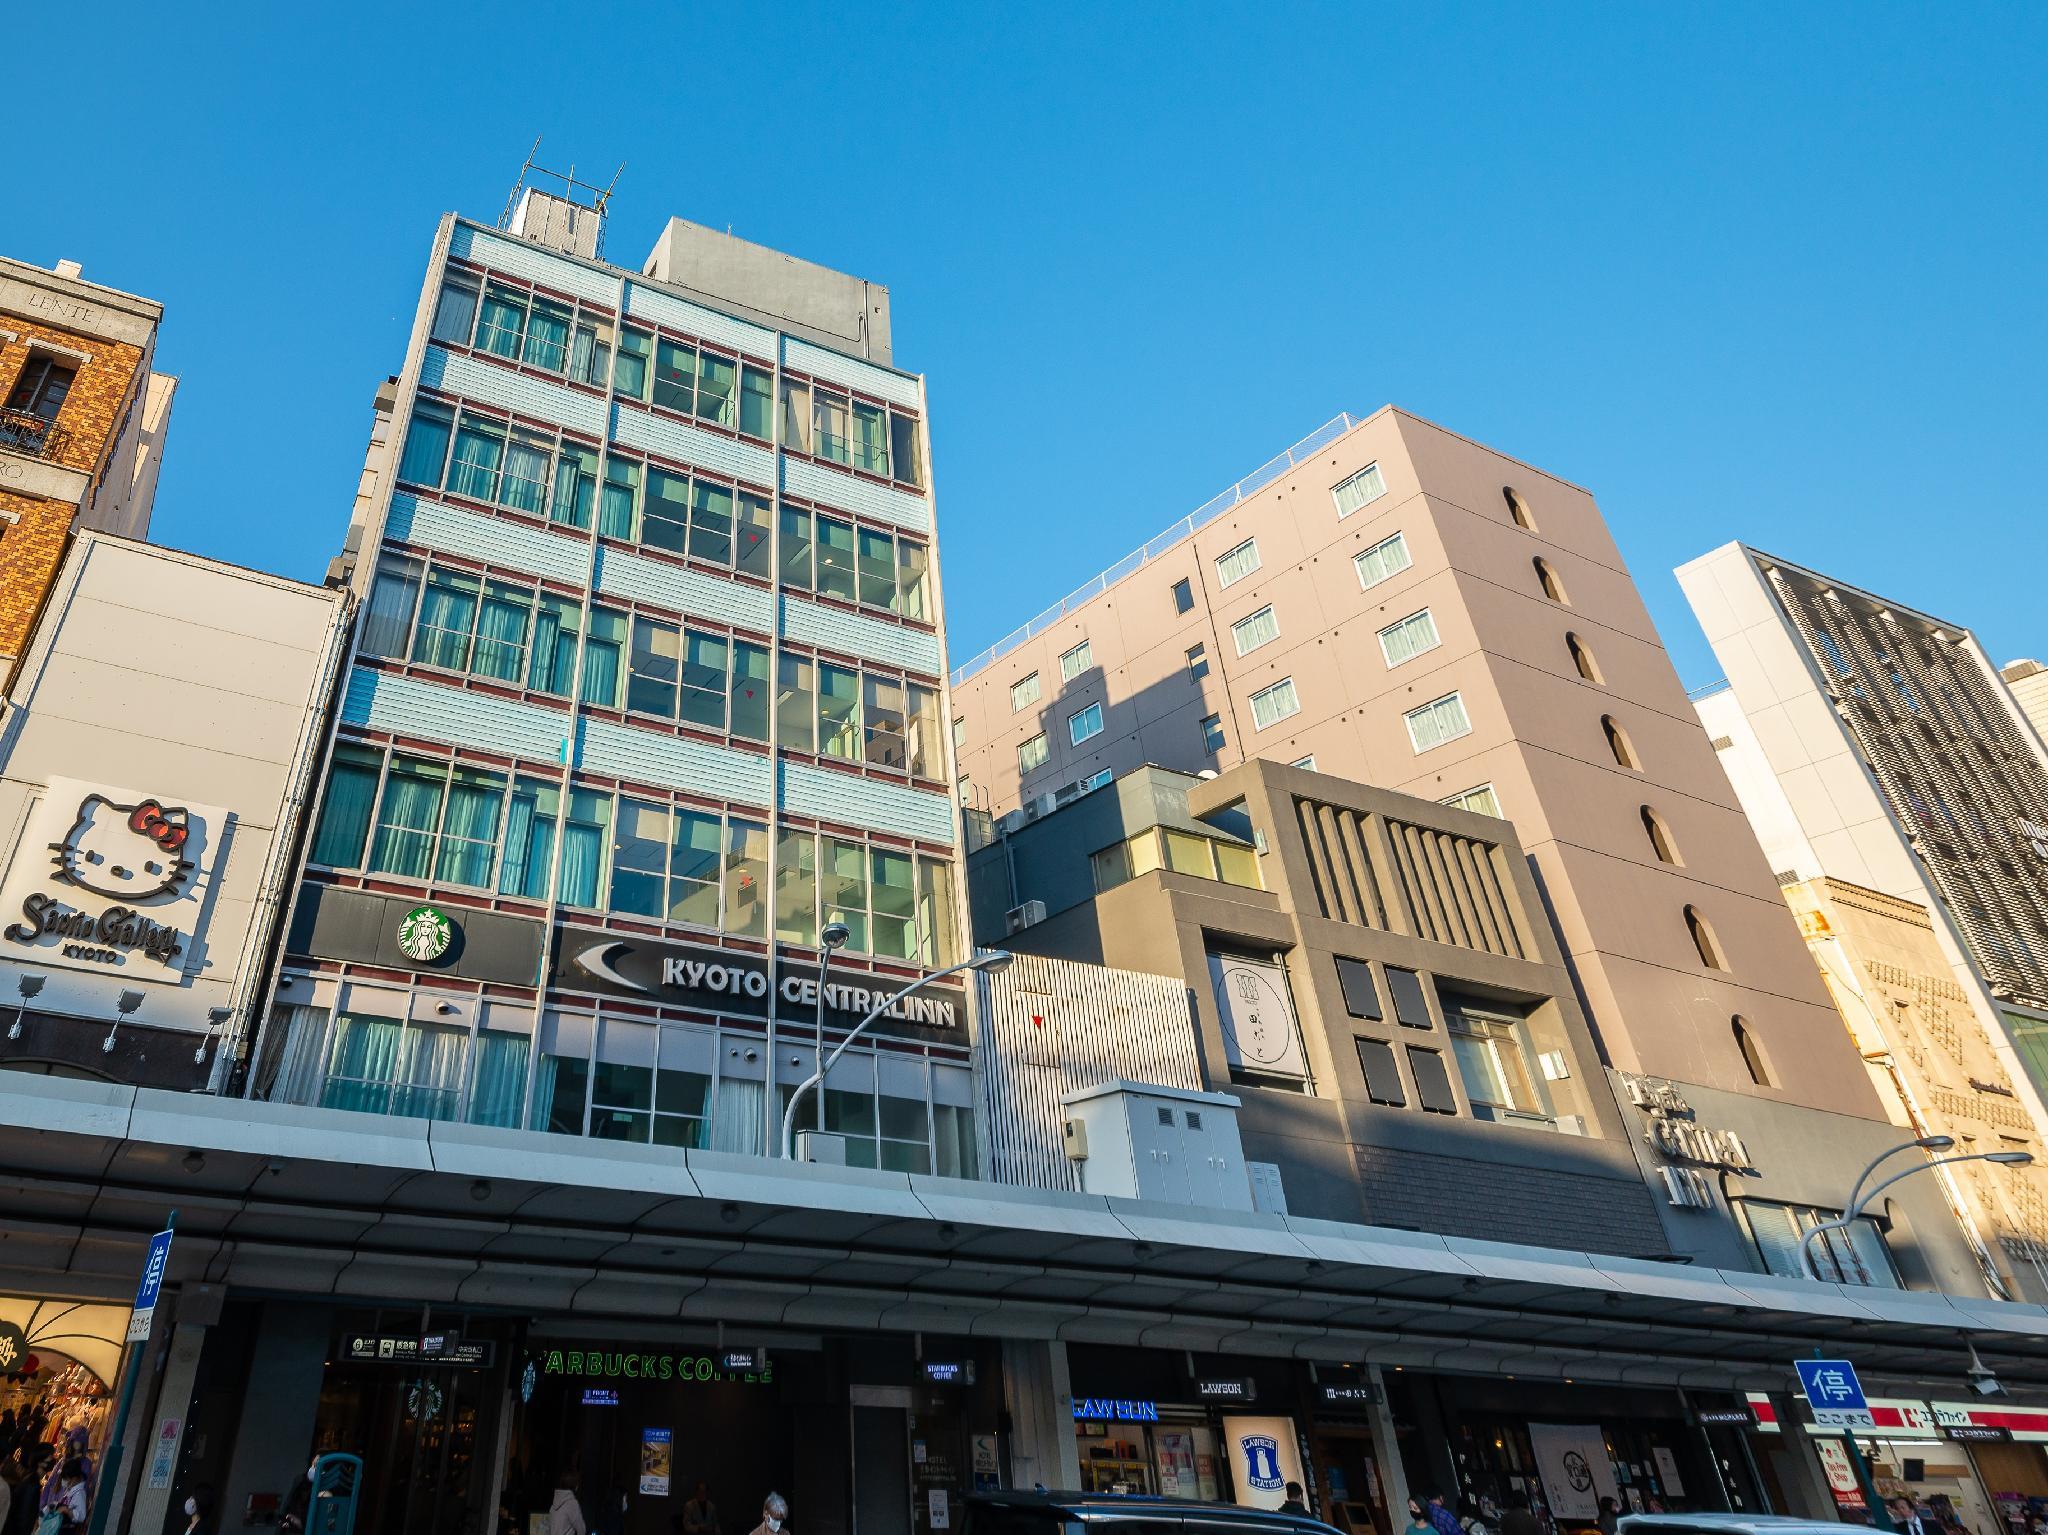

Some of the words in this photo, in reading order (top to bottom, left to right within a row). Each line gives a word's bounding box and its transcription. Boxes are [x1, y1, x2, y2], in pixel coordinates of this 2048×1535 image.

[4, 893, 94, 941] Sanrio
[95, 906, 183, 967] Gallery
[61, 943, 118, 964] KYOTO
[662, 956, 767, 998] KYOTO
[780, 976, 905, 1019] CENTRAL
[904, 995, 956, 1028] INN
[537, 1350, 673, 1380] ARBUCKS
[678, 1356, 773, 1383] COE
[927, 1364, 958, 1373] STARBUCKS
[1199, 1383, 1242, 1395] LAWSON
[1811, 1368, 1854, 1402] 停
[1072, 1397, 1159, 1421] LAWSON
[1817, 1412, 1872, 1425] ここまで
[1243, 1437, 1276, 1451] LAWSON
[1249, 1476, 1283, 1489] STATION
